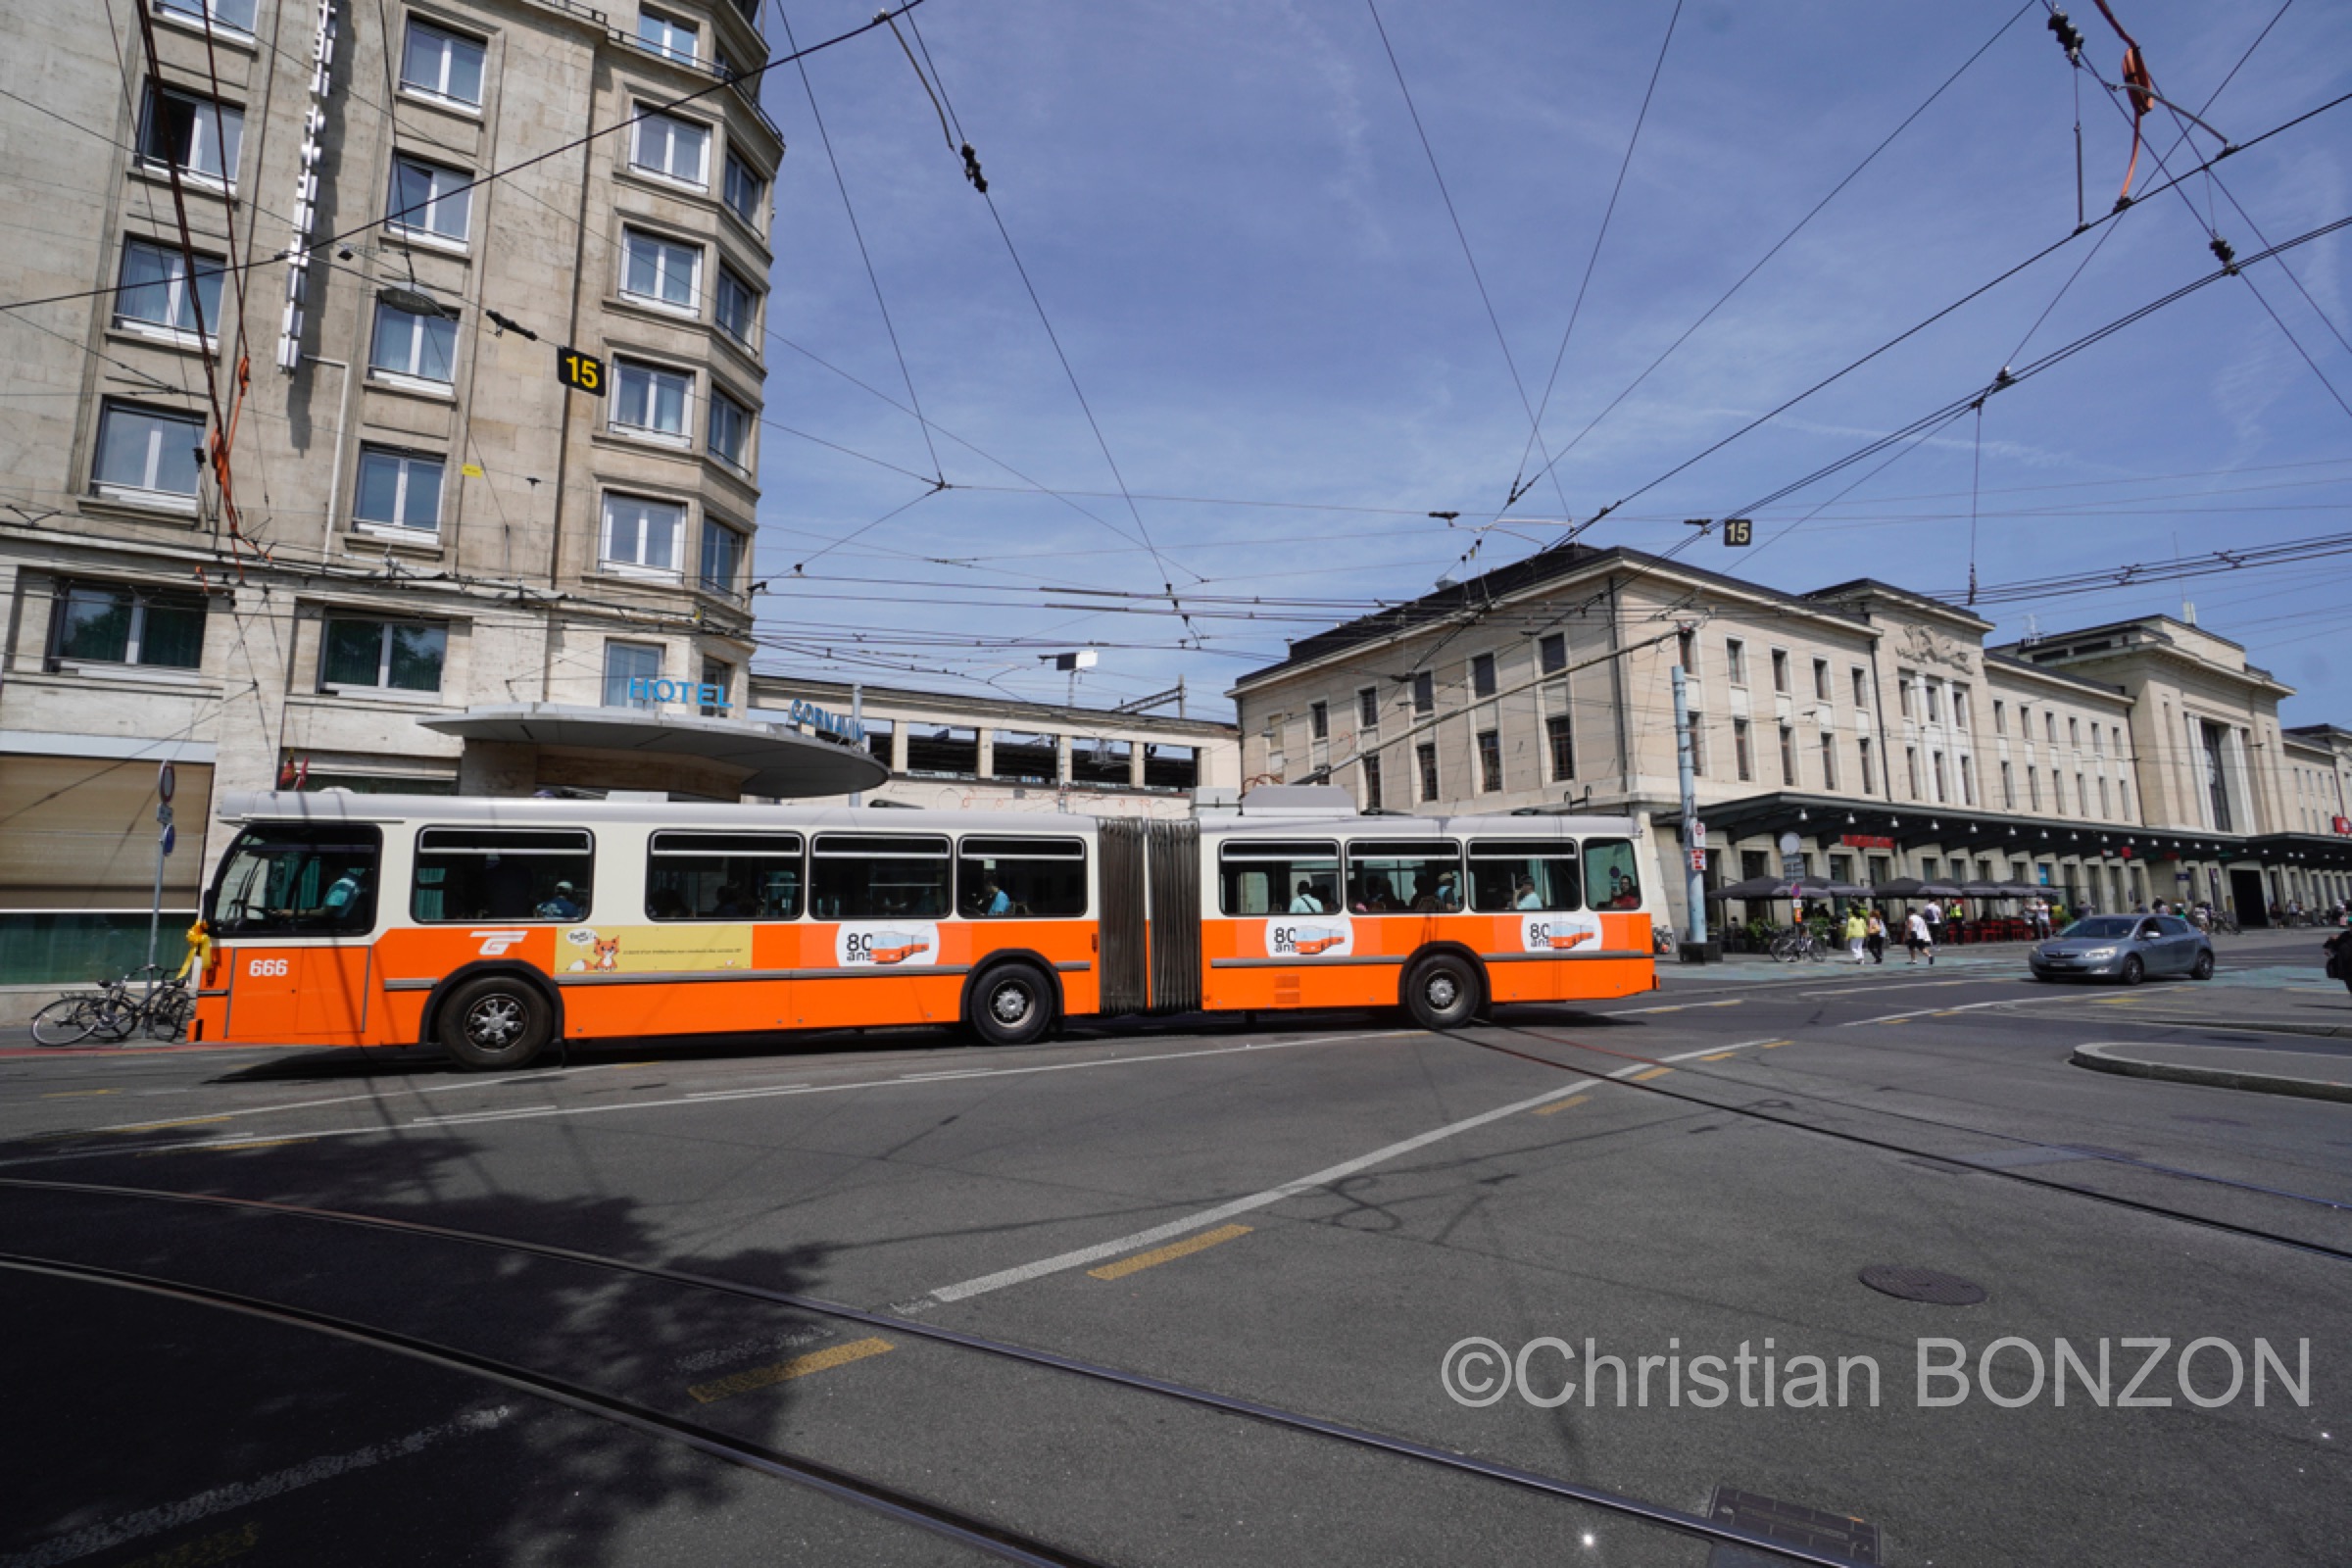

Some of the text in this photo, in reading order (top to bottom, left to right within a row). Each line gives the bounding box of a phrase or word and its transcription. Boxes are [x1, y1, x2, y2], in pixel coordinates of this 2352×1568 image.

[565, 356, 599, 389] 15
[1727, 522, 1749, 543] 15
[628, 676, 734, 708] HOTEL
[249, 958, 289, 977] 666
